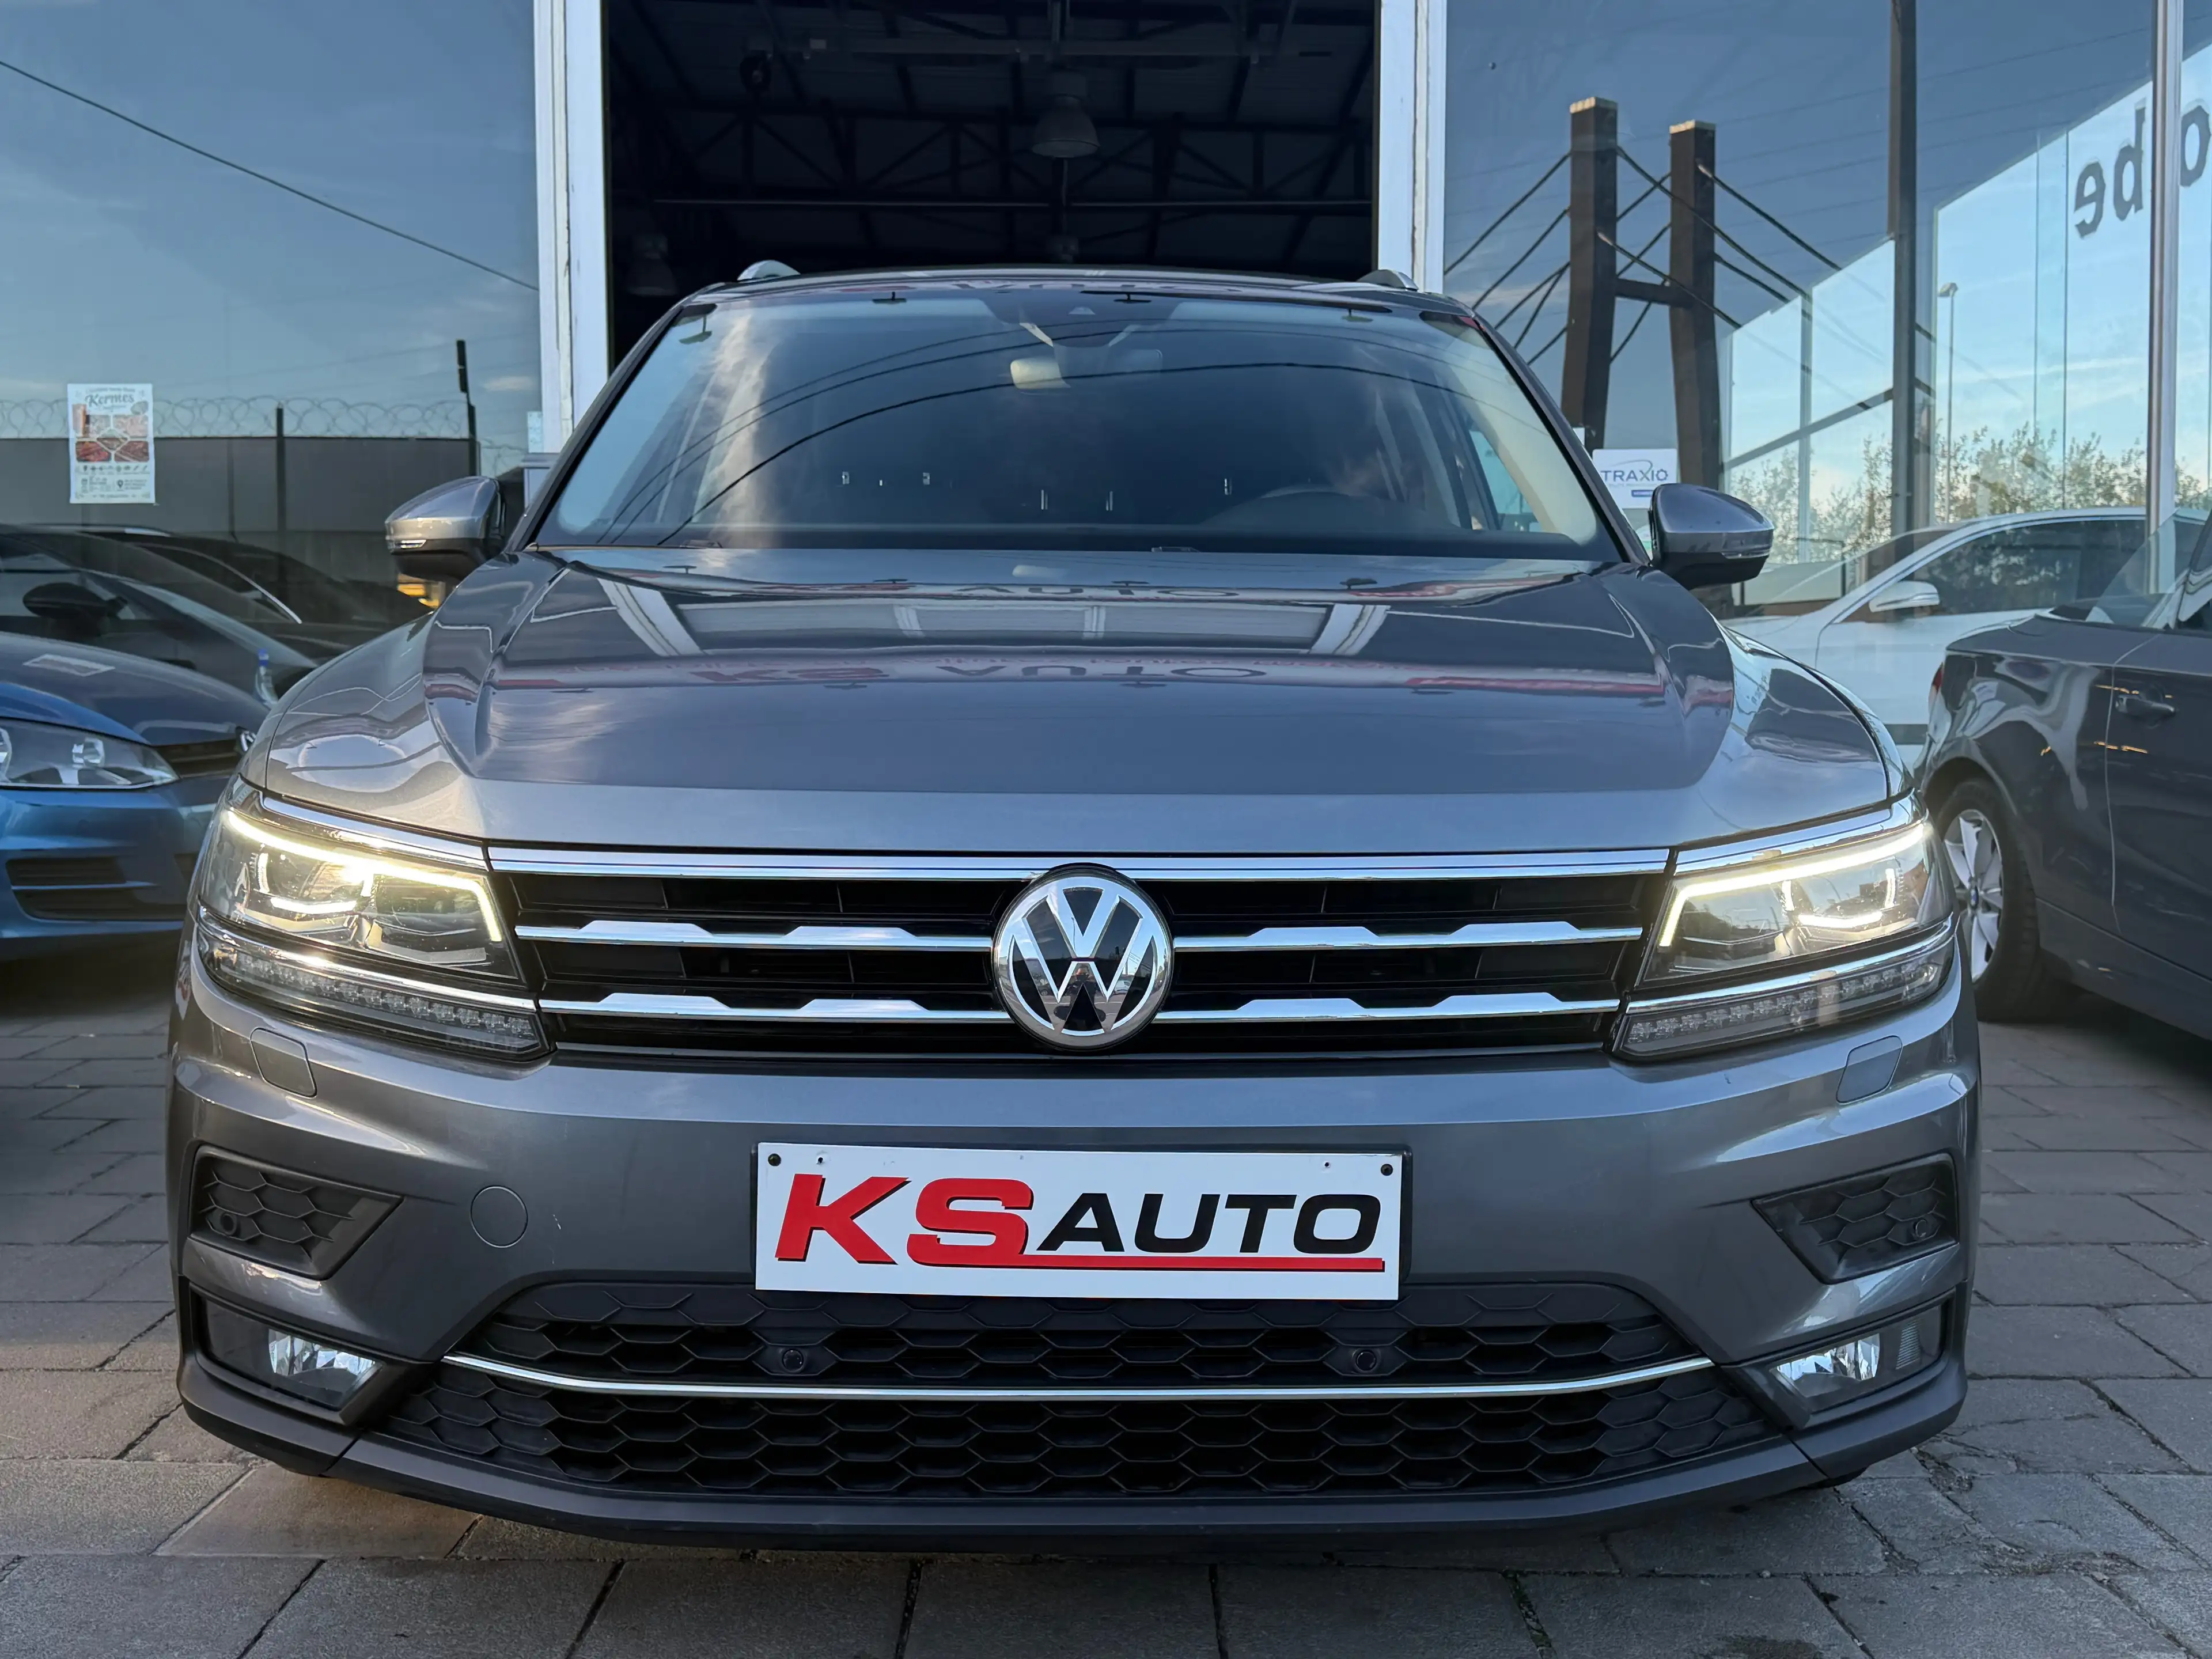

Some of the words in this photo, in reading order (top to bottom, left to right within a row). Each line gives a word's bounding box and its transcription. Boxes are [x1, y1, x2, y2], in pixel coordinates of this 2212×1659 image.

[1600, 467, 1668, 482] TRAXIO
[1001, 878, 1167, 1044] VW
[775, 1172, 1034, 1266] KS
[1036, 1192, 1381, 1254] AUTO
